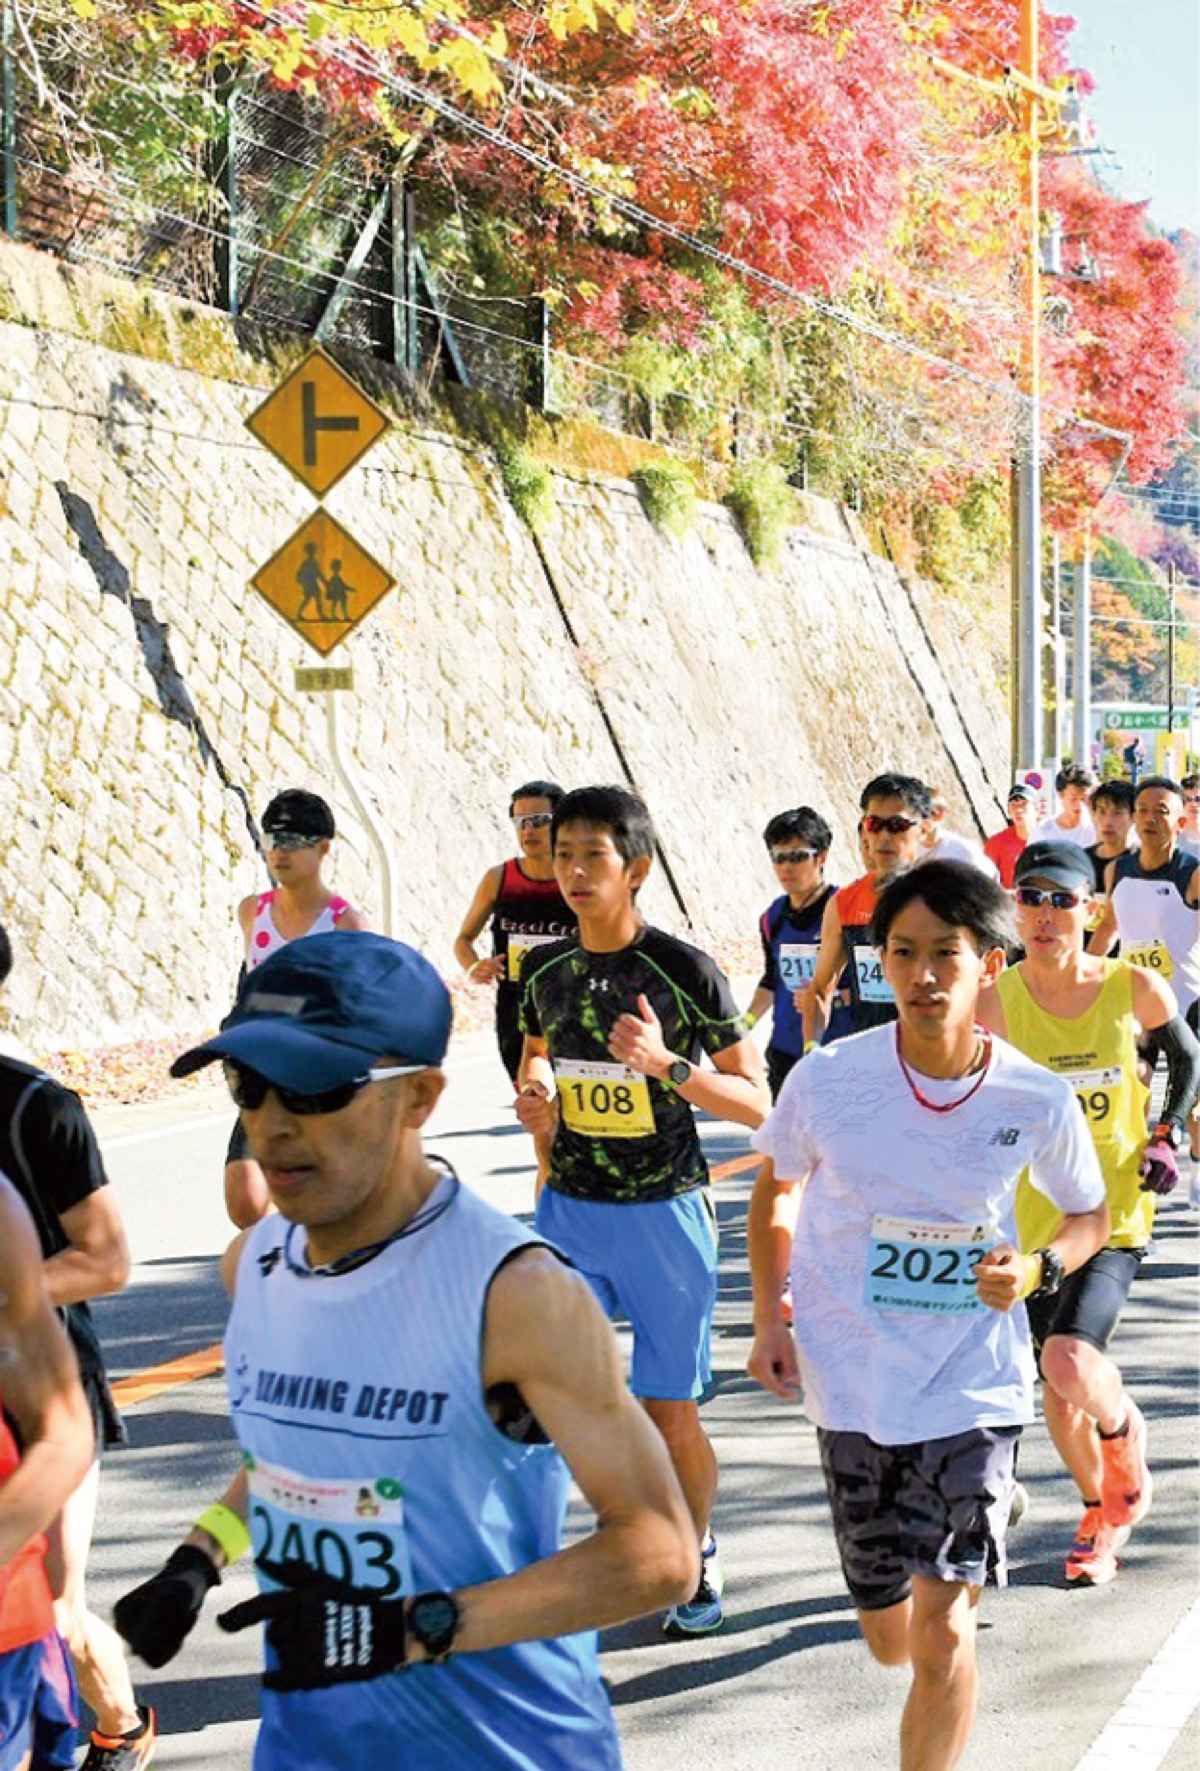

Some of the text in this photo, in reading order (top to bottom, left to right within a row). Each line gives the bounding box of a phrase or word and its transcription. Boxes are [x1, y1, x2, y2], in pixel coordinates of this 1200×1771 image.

[571, 1083, 635, 1114] 108
[870, 1243, 986, 1285] 2023
[352, 1384, 449, 1425] DEPOT
